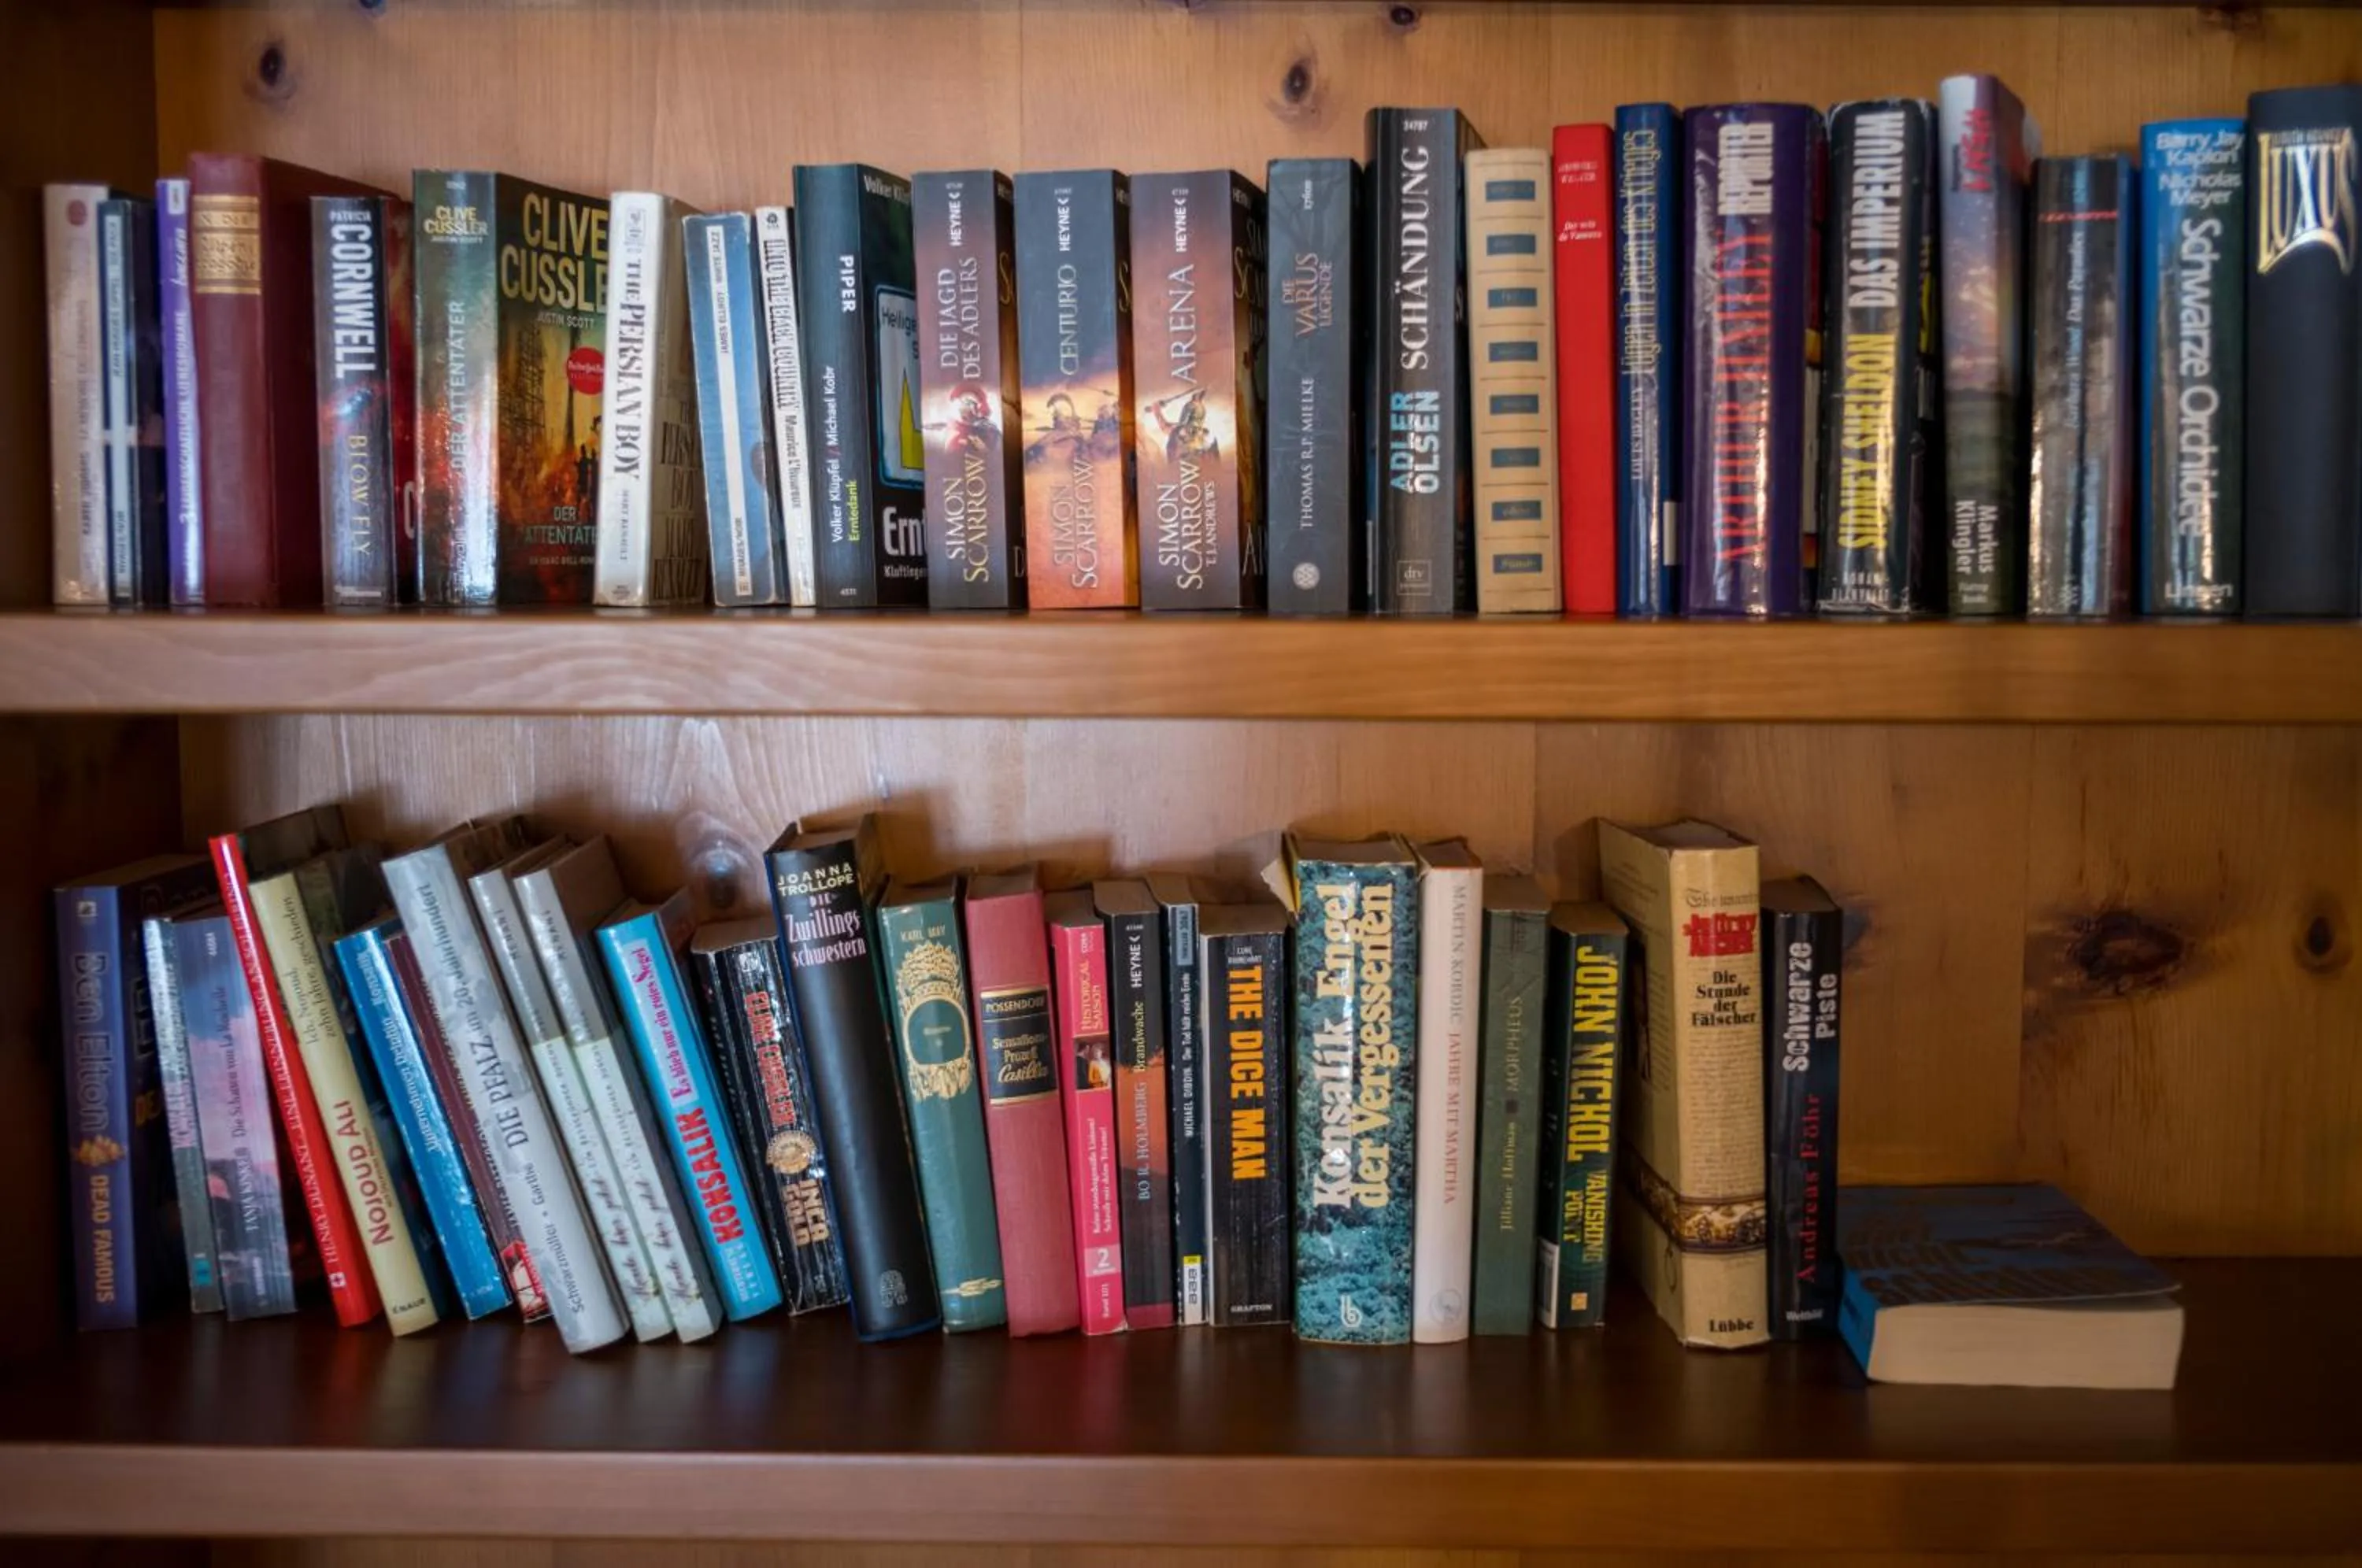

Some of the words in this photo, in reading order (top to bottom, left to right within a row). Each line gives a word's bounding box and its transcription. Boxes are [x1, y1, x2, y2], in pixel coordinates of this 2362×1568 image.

[1619, 129, 1660, 198] Krieges
[1717, 121, 1775, 216] REPORTER
[2157, 131, 2213, 152] Barry
[2212, 129, 2245, 150] Jay
[1850, 111, 1905, 250] IMPERIUM
[2158, 169, 2242, 191] Nicholas
[2169, 187, 2233, 210] Meyer
[2257, 128, 2358, 276] LUXUS
[329, 210, 372, 223] PATRICIA
[424, 219, 489, 236] CUSSLER
[435, 205, 477, 222] CLIVE
[523, 191, 609, 261] CLIVE
[710, 231, 722, 253] JAZZ
[948, 200, 962, 246] HEYNE
[1057, 206, 1071, 252] HEYNE
[1174, 206, 1187, 253] HEYNE
[1620, 202, 1656, 232] des
[625, 259, 643, 302] THE
[764, 239, 790, 272] INTO
[839, 254, 856, 312] PIPER
[1395, 146, 1429, 370] SCHÄNDUNG
[1620, 240, 1657, 294] Zeiten
[1848, 257, 1899, 308] DAS
[2067, 231, 2086, 290] Paradies
[330, 223, 376, 379] CORNWELL
[768, 276, 788, 303] THE
[937, 268, 962, 327] JAGD
[958, 256, 981, 336] ADLERS
[1283, 279, 1295, 304] DIE
[1295, 252, 1320, 337] VARUS
[1319, 261, 1333, 327] LEGENDE
[1714, 231, 1772, 386] HAILEY
[2065, 295, 2083, 323] Das
[2179, 217, 2223, 378] Schwarze
[566, 314, 595, 329] SCOTT
[718, 325, 730, 353] JAMES
[1057, 264, 1079, 375] CENTURIO
[1168, 264, 1198, 383] ARENA
[448, 300, 466, 424] ATTENTÄTER
[617, 303, 646, 417] PERSIAN
[939, 333, 960, 368] DIE
[961, 340, 982, 379] DES
[1621, 324, 1660, 375] Lügen
[774, 347, 800, 411] COUNTRY
[823, 364, 836, 394] Kobr
[1301, 376, 1315, 433] MIELKE
[1841, 332, 1895, 449] SHELDON
[2067, 372, 2080, 429] Barbara
[450, 429, 468, 472] DER
[785, 415, 798, 457] Maurice
[824, 398, 839, 446] Michael
[1390, 391, 1414, 494] ADLER
[1412, 390, 1440, 494] OLSEN
[347, 434, 369, 506] BLOW
[614, 423, 642, 480] BOY
[2179, 384, 2220, 537] Orchidee
[846, 479, 861, 542] Erntedank
[1300, 463, 1315, 530] THOMAS
[1713, 400, 1768, 567] ARTHUR
[1837, 456, 1888, 549] SIDNEY
[351, 516, 372, 557] FLY
[553, 505, 576, 521] DER
[830, 504, 843, 542] Volker
[942, 477, 967, 560] SIMON
[963, 452, 990, 582] SCARROW
[1052, 485, 1075, 565] SIMON
[1071, 458, 1098, 589] SCARROW
[1157, 483, 1180, 567] SIMON
[1176, 460, 1203, 590] SCARROW
[1204, 481, 1216, 549] ANDREWS
[1951, 499, 1977, 575] Klingler
[1977, 505, 1999, 573] Markus
[777, 862, 853, 886] JOANNA
[779, 873, 856, 897] TROLLOPE
[809, 892, 833, 908] DIE
[281, 893, 313, 969] geschieden
[413, 881, 466, 985] Jahrhundert
[784, 908, 861, 944] Zwillings
[899, 927, 925, 943] KARL
[926, 923, 947, 938] MAY
[1316, 882, 1356, 1001] Engel
[1449, 884, 1468, 952] MARTIN
[1683, 912, 1758, 937] Jeffrey
[352, 949, 389, 1008] Konsalik
[628, 947, 652, 982] Segel
[791, 937, 867, 967] schwestern
[1128, 943, 1142, 989] HEYNE
[1712, 971, 1738, 985] Die
[72, 952, 110, 1023] Ben
[450, 982, 477, 1011] 20.
[644, 979, 662, 1010] rotes
[1075, 960, 1094, 1030] HISTORICAL
[1089, 984, 1105, 1030] SAISON
[1180, 993, 1190, 1015] reiche
[1227, 963, 1263, 1023] THE
[1352, 882, 1400, 1140] Vergessenen
[1573, 945, 1619, 1033] JOHN
[1694, 983, 1751, 1000] Stunde
[1712, 998, 1738, 1013] der
[1782, 941, 1812, 1071] Schwarze
[1815, 973, 1838, 1039] Piste
[218, 1034, 234, 1048] La
[316, 1006, 338, 1040] zehn
[377, 1015, 409, 1067] Delphin
[461, 1011, 483, 1036] im
[650, 1008, 671, 1030] ein
[661, 1026, 679, 1051] nur
[742, 988, 778, 1045] CLIVE
[1129, 1000, 1148, 1073] Brandwache
[1182, 1031, 1191, 1045] Tod
[1501, 995, 1524, 1093] MORPHEUS
[1690, 1011, 1758, 1027] Fälscher
[74, 1030, 115, 1131] Elton
[222, 1049, 237, 1071] von
[468, 1034, 514, 1107] PFALZ
[663, 1048, 687, 1079] blieb
[1182, 1046, 1192, 1060] Der
[1229, 1030, 1265, 1100] DICE
[1444, 1032, 1463, 1089] JAHRE
[394, 1066, 442, 1154] Unternehmen
[667, 1076, 694, 1099] Es
[754, 1042, 797, 1130] CUSSLER
[1312, 1015, 1354, 1209] Konsalik
[1443, 1092, 1461, 1126] MIT
[1566, 1040, 1616, 1165] NICHOL
[229, 1117, 246, 1139] Die
[332, 1100, 365, 1142] ALI
[494, 1105, 530, 1151] DIE
[1132, 1081, 1149, 1159] HOLMBERG
[1183, 1100, 1194, 1137] MICHAEL
[1231, 1109, 1267, 1182] MAN
[1798, 1093, 1820, 1159] Föhr
[682, 1105, 746, 1246] KONSALIK
[1353, 1145, 1391, 1209] der
[1440, 1128, 1460, 1205] MARTHA
[1501, 1121, 1517, 1180] Hoffman
[90, 1173, 111, 1222] DEAD
[239, 1194, 260, 1233] TANJA
[347, 1142, 394, 1247] NOJOUD
[779, 1182, 811, 1248] GOLD
[798, 1177, 830, 1244] INCA
[1136, 1179, 1150, 1200] BO
[1581, 1169, 1608, 1264] VANISHING
[312, 1208, 340, 1263] HENRY
[1795, 1169, 1820, 1284] Andreas
[92, 1226, 115, 1303] FAMOUS
[540, 1222, 586, 1315] Schwarzmüller
[1095, 1247, 1111, 1268] 2
[392, 1296, 427, 1315] KNAUR
[1230, 1304, 1273, 1313] GRAFTON
[1708, 1317, 1755, 1334] Lübbe
[1785, 1308, 1825, 1323] Weltbild
